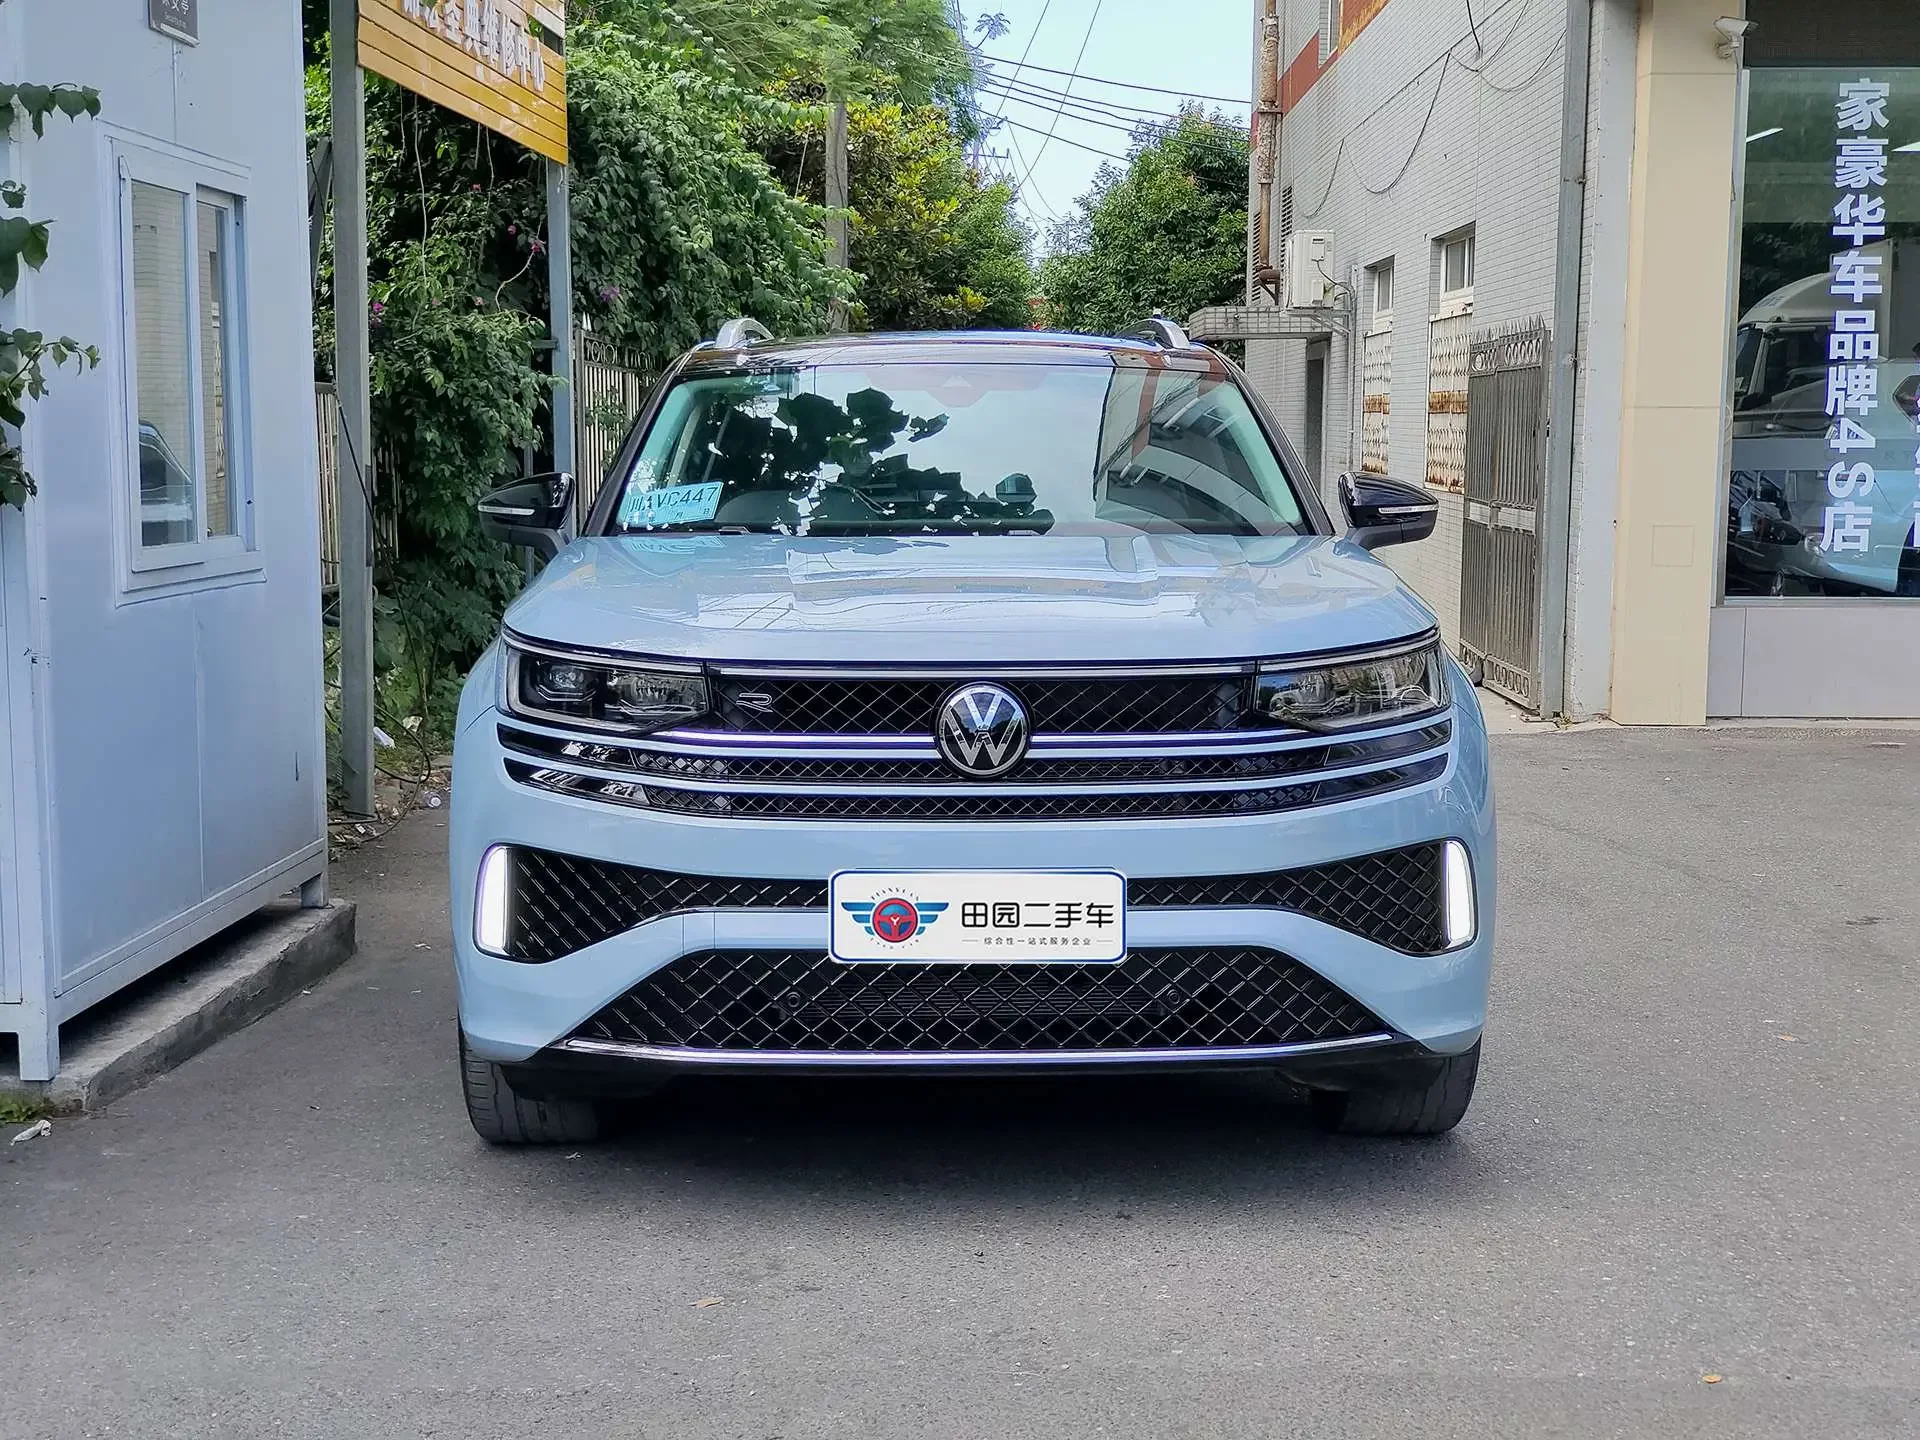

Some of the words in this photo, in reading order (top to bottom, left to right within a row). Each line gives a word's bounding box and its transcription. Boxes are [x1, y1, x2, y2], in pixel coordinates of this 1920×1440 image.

[1820, 78, 1890, 555] 家豪华车品牌4S店
[961, 902, 1115, 929] 田园二手车
[983, 936, 1092, 946] 综合性一站式服务企业
